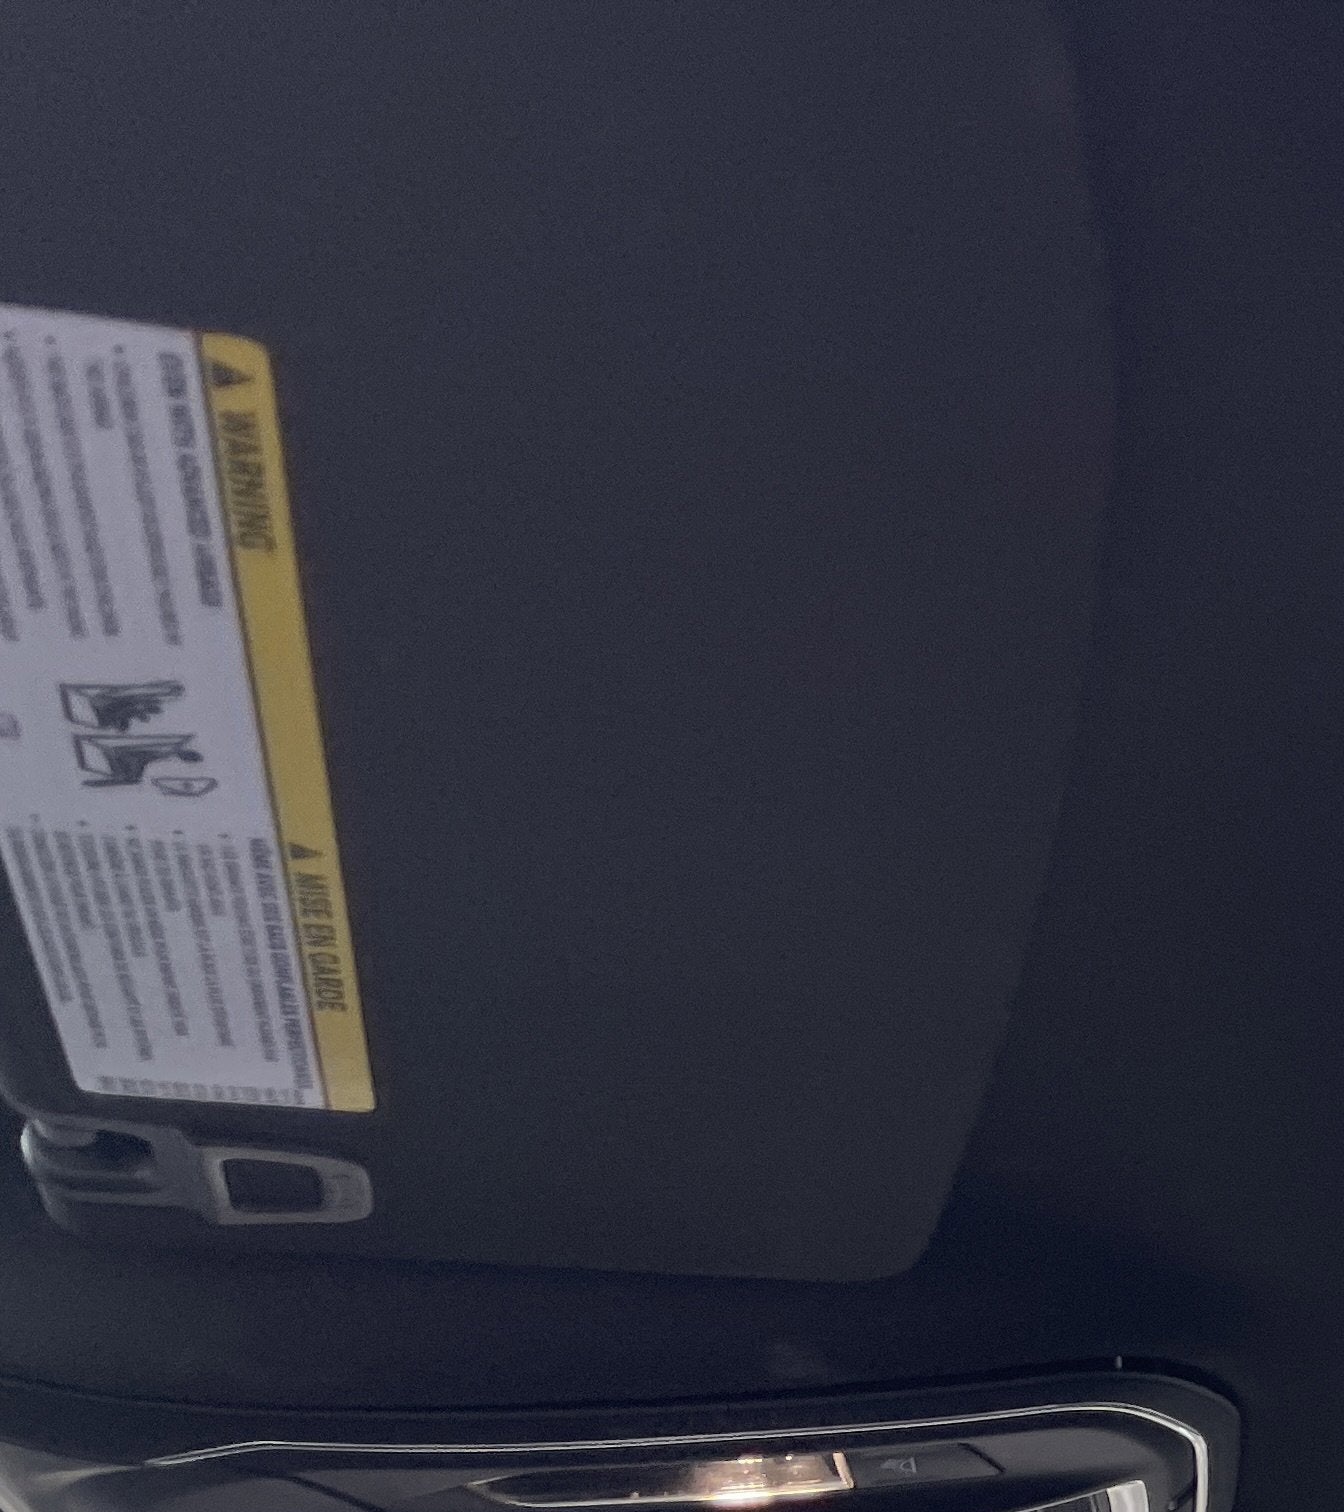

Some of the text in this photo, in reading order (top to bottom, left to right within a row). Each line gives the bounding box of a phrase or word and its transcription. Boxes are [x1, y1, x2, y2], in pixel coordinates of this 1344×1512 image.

[219, 411, 278, 555] WARNING
[294, 871, 348, 1012] MISE EN GARDE
